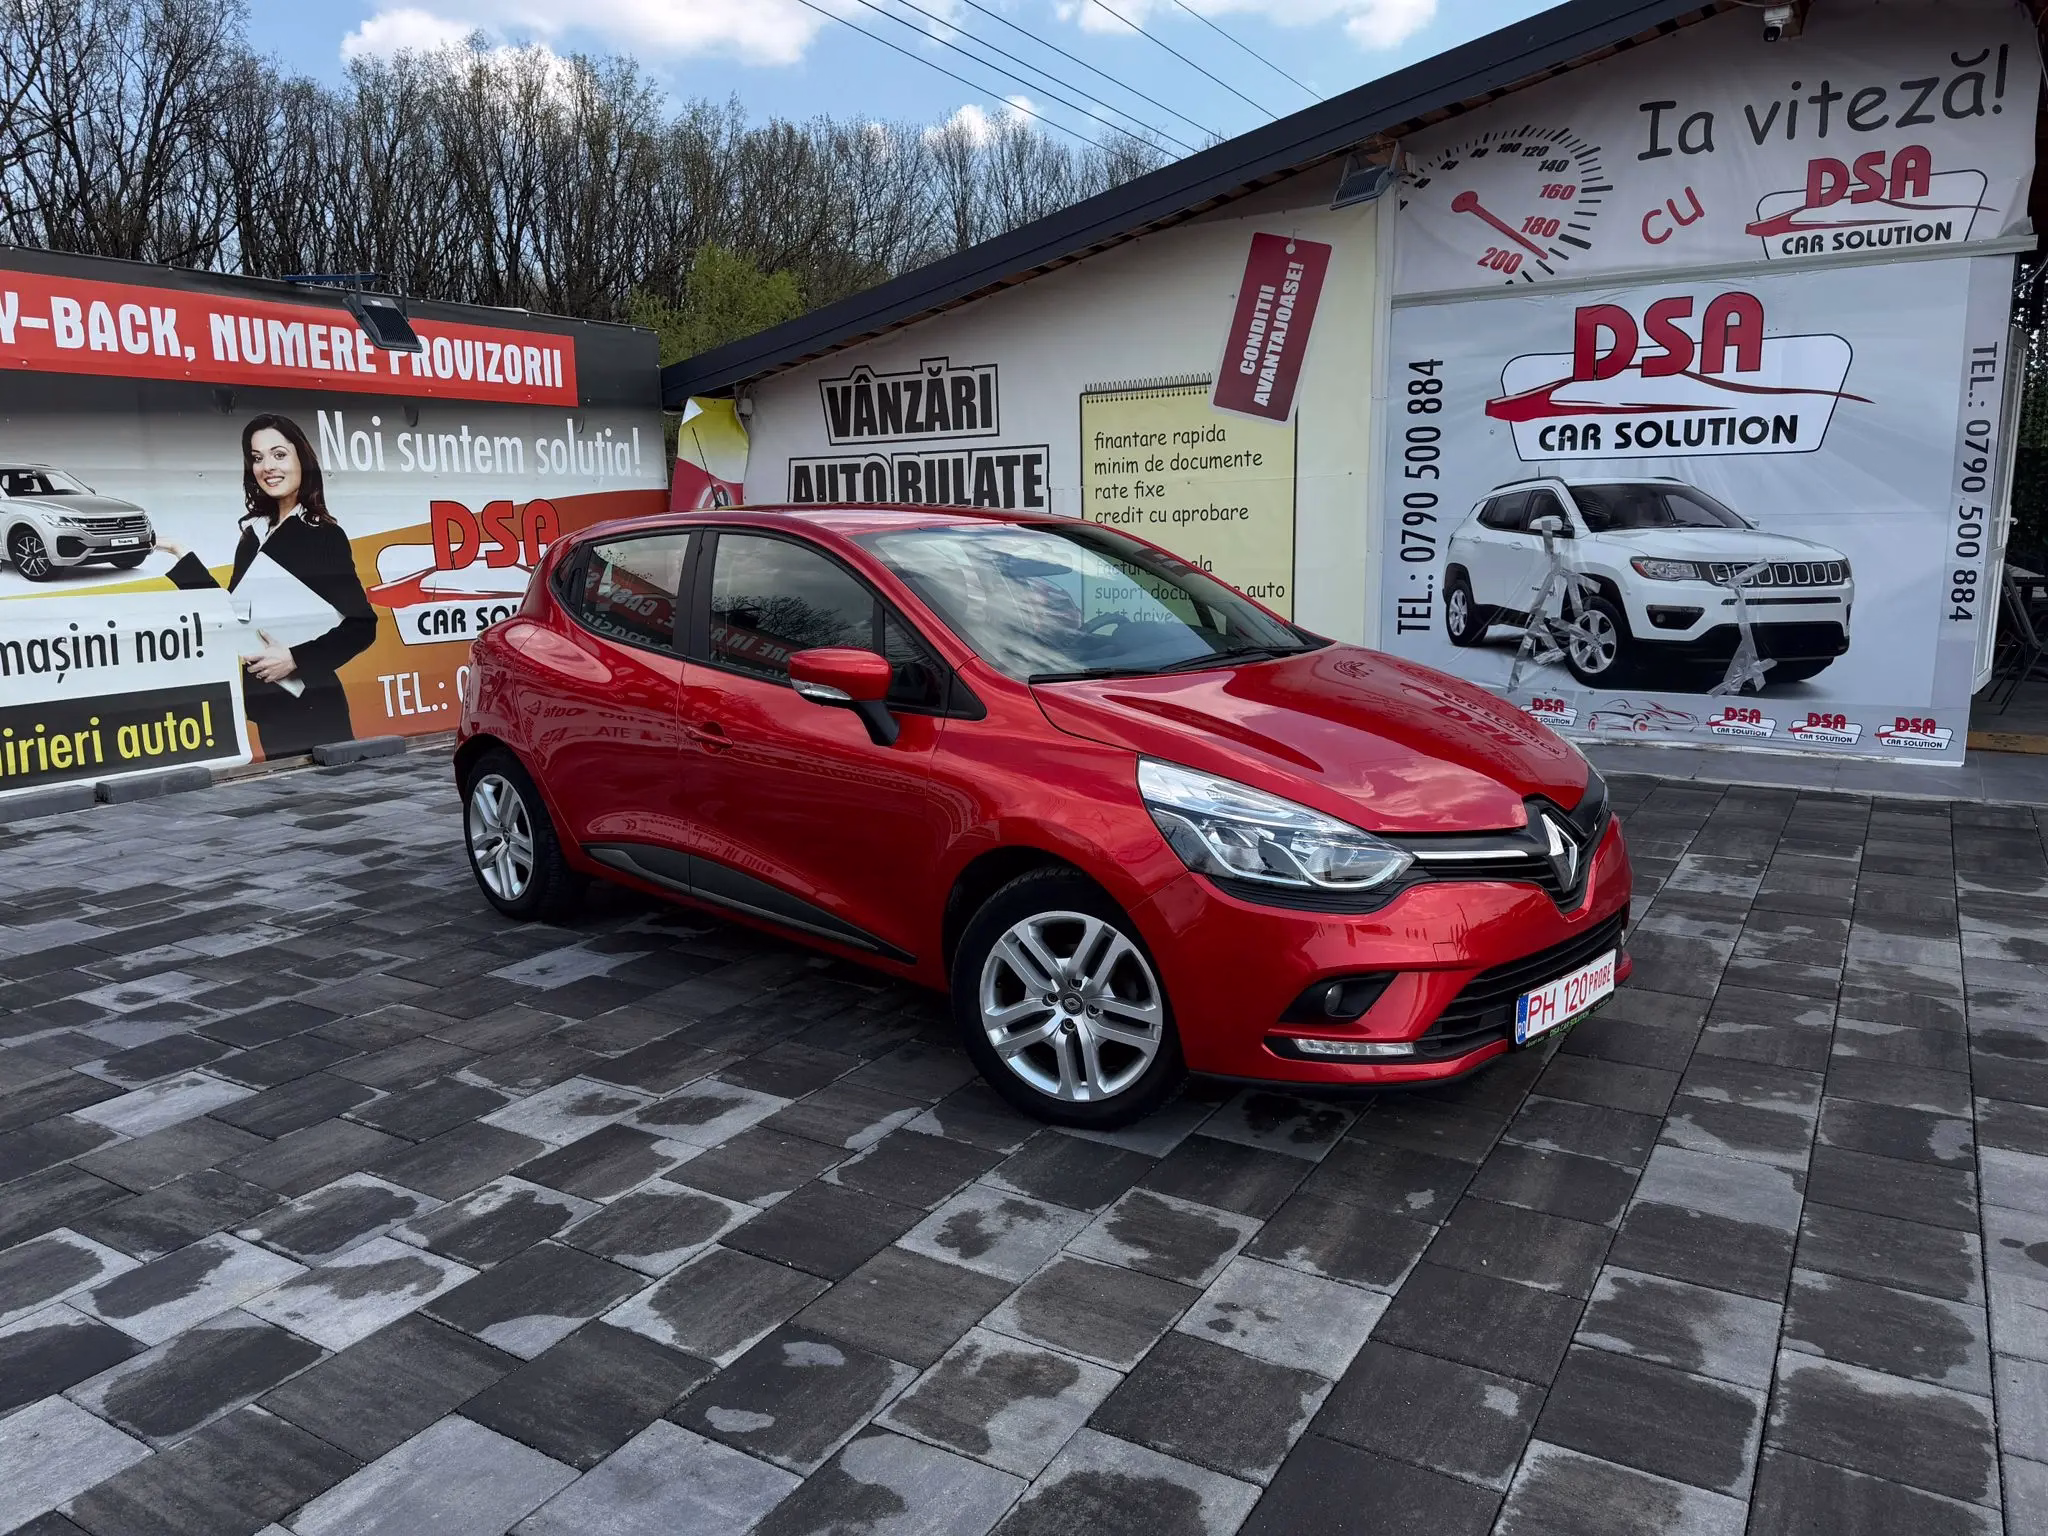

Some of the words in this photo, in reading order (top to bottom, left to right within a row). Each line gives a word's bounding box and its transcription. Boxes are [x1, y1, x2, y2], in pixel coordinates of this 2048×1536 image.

[1637, 100, 1715, 161] Ia
[1744, 43, 2010, 146] viteză!
[1497, 142, 1522, 153] 100
[1521, 145, 1550, 157] 120
[1538, 159, 1570, 173] 140
[1539, 183, 1576, 200] 160
[1806, 144, 1932, 209] DSA
[1520, 215, 1561, 238] 180
[1641, 186, 1705, 245] cu
[1781, 233, 1824, 256] CAR
[1832, 221, 1952, 252] SOLUTION
[1477, 246, 1524, 275] 200
[209, 313, 377, 374] NUMERE
[1239, 284, 1277, 375] CONDITII
[1253, 261, 1305, 407] AVANTAJOASE!
[1573, 291, 1765, 382] DSA
[1407, 358, 1444, 415] 884
[1968, 341, 1998, 408] TEL.:
[826, 366, 993, 437] VÂNZĂRI
[317, 410, 385, 471] Noi
[397, 425, 524, 474] suntem
[1094, 431, 1167, 450] finantare
[1173, 424, 1226, 449] rapida
[1404, 426, 1441, 480] 500
[1538, 423, 1601, 451] CAR
[1614, 414, 1799, 450] SOLUTION
[1094, 457, 1139, 475] minim
[1145, 454, 1164, 472] de
[1170, 450, 1263, 471] documente
[1960, 419, 1992, 493] 0790
[1095, 486, 1128, 499] rate
[1134, 480, 1165, 499] fixe
[430, 499, 561, 570] DSA
[1095, 506, 1144, 525] credit
[1150, 510, 1167, 523] cu
[1172, 504, 1249, 527] aprobare
[1399, 492, 1439, 563] 0790
[1955, 505, 1983, 558] 500
[1247, 582, 1285, 598] auto
[1397, 573, 1434, 635] TEL.:
[1948, 569, 1977, 622] 884
[135, 612, 204, 663] noi!
[417, 608, 467, 636] CAR
[377, 671, 448, 718] TEL.:
[1532, 697, 1565, 713] DSA
[1724, 707, 1761, 724] DSA
[0, 716, 103, 777] irieri
[117, 700, 214, 760] auto!
[1540, 717, 1571, 725] SOLUTION
[1716, 727, 1731, 735] CAR
[1731, 728, 1767, 737] SOLUTION
[1799, 733, 1814, 741] CAR
[1815, 734, 1852, 743] SOLUTION
[1807, 712, 1846, 729] DSA
[1894, 717, 1936, 734] DSA
[1886, 738, 1903, 747] CAR
[1903, 739, 1943, 749] SOLUTION
[1528, 987, 1557, 1032] PH
[1564, 972, 1588, 1015] 120
[1589, 962, 1612, 994] PROBE
